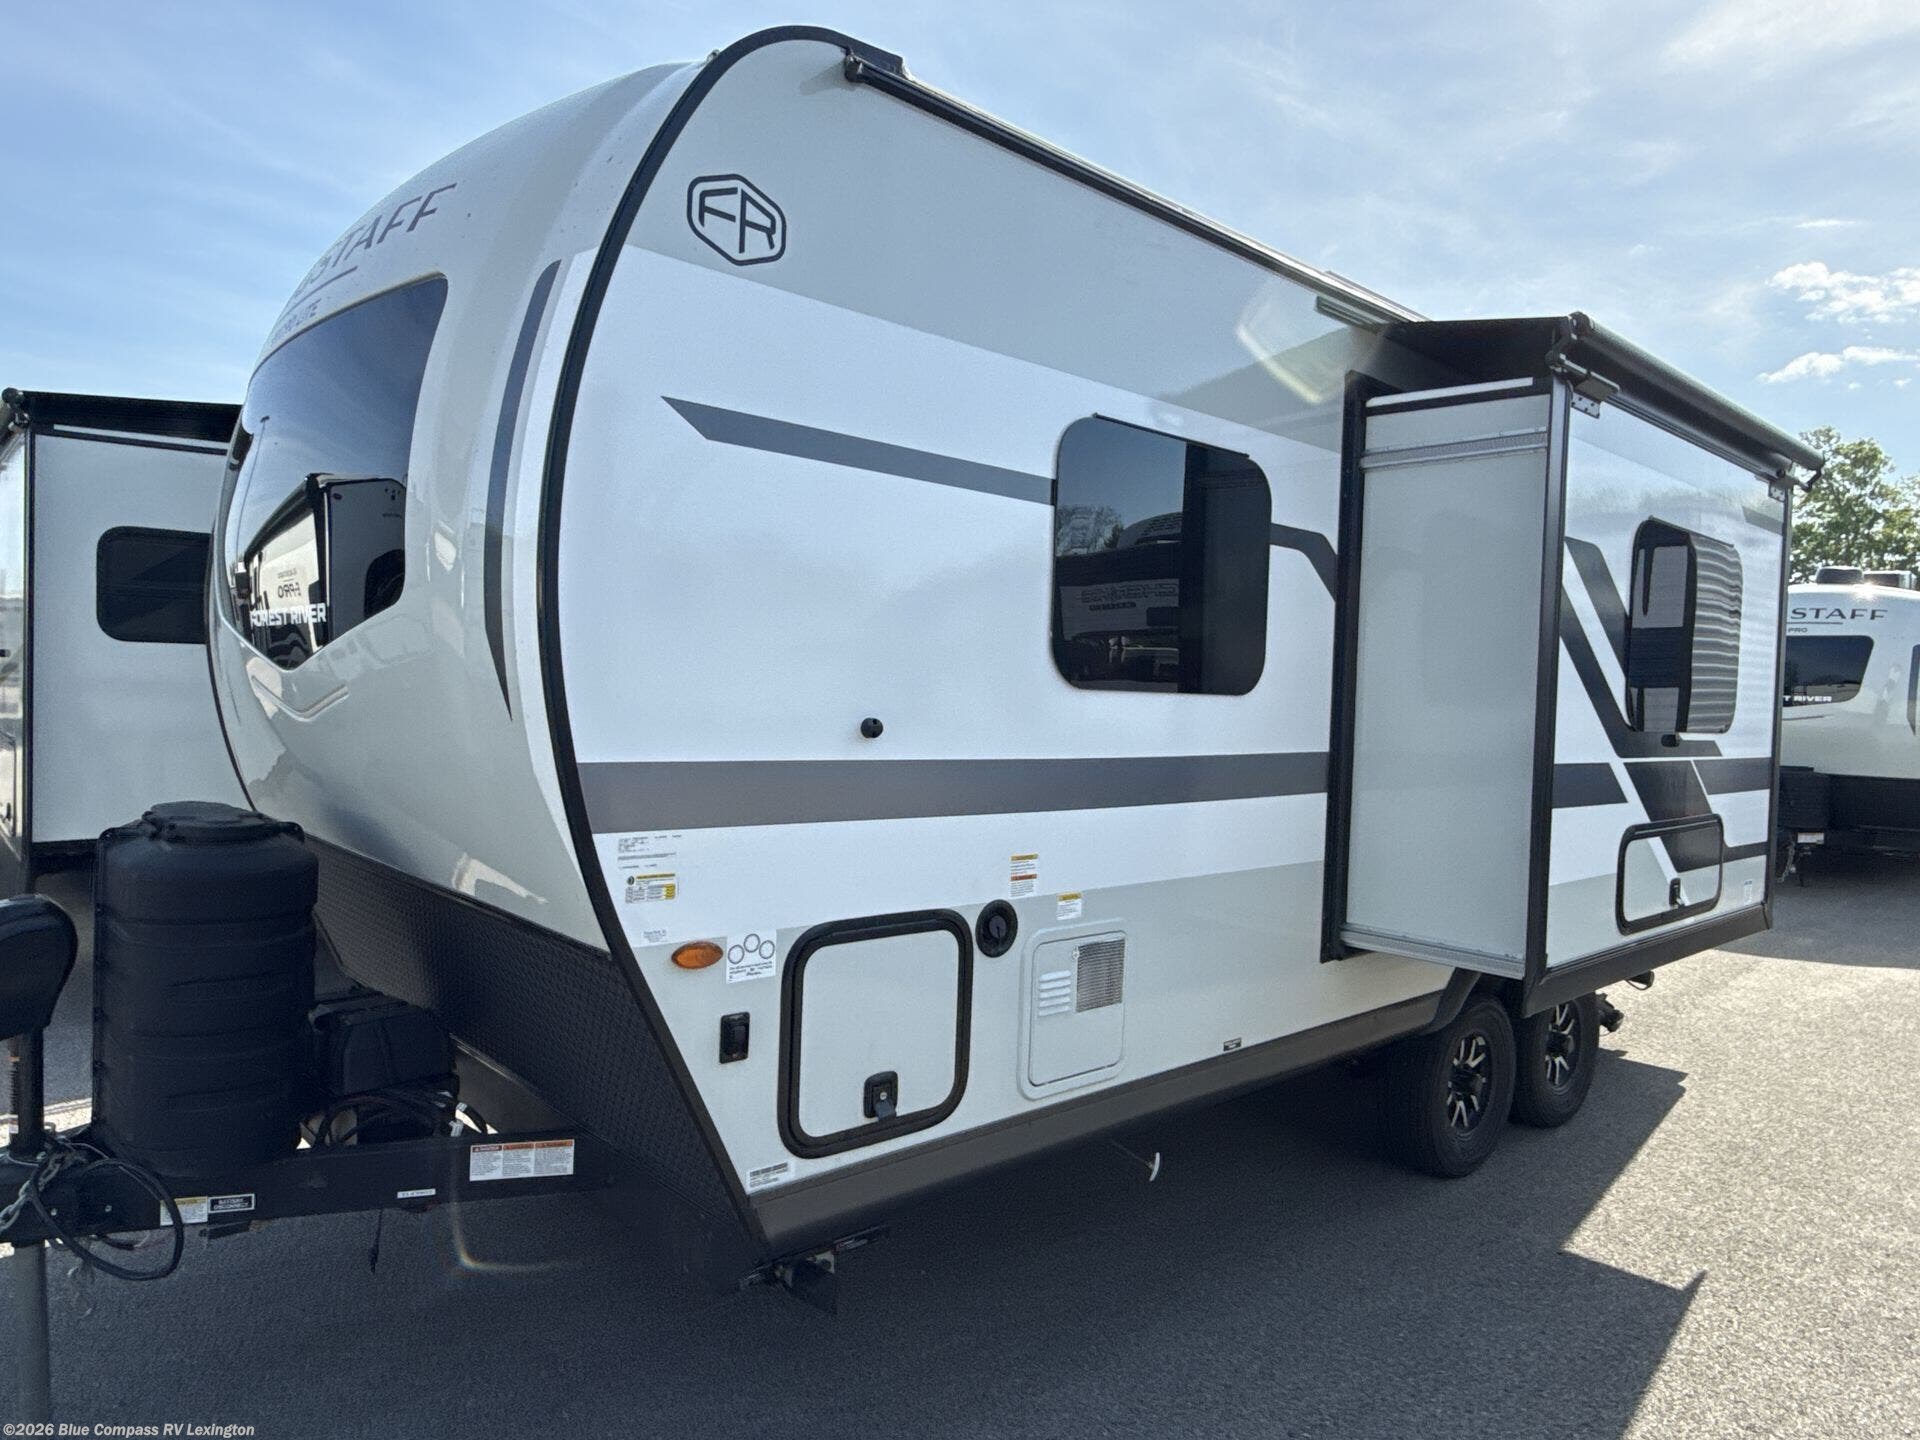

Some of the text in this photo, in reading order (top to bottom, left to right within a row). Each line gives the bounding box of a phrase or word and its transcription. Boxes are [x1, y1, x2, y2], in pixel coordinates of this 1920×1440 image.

[698, 186, 777, 254] FR
[249, 602, 327, 627] FOREST RIVER
